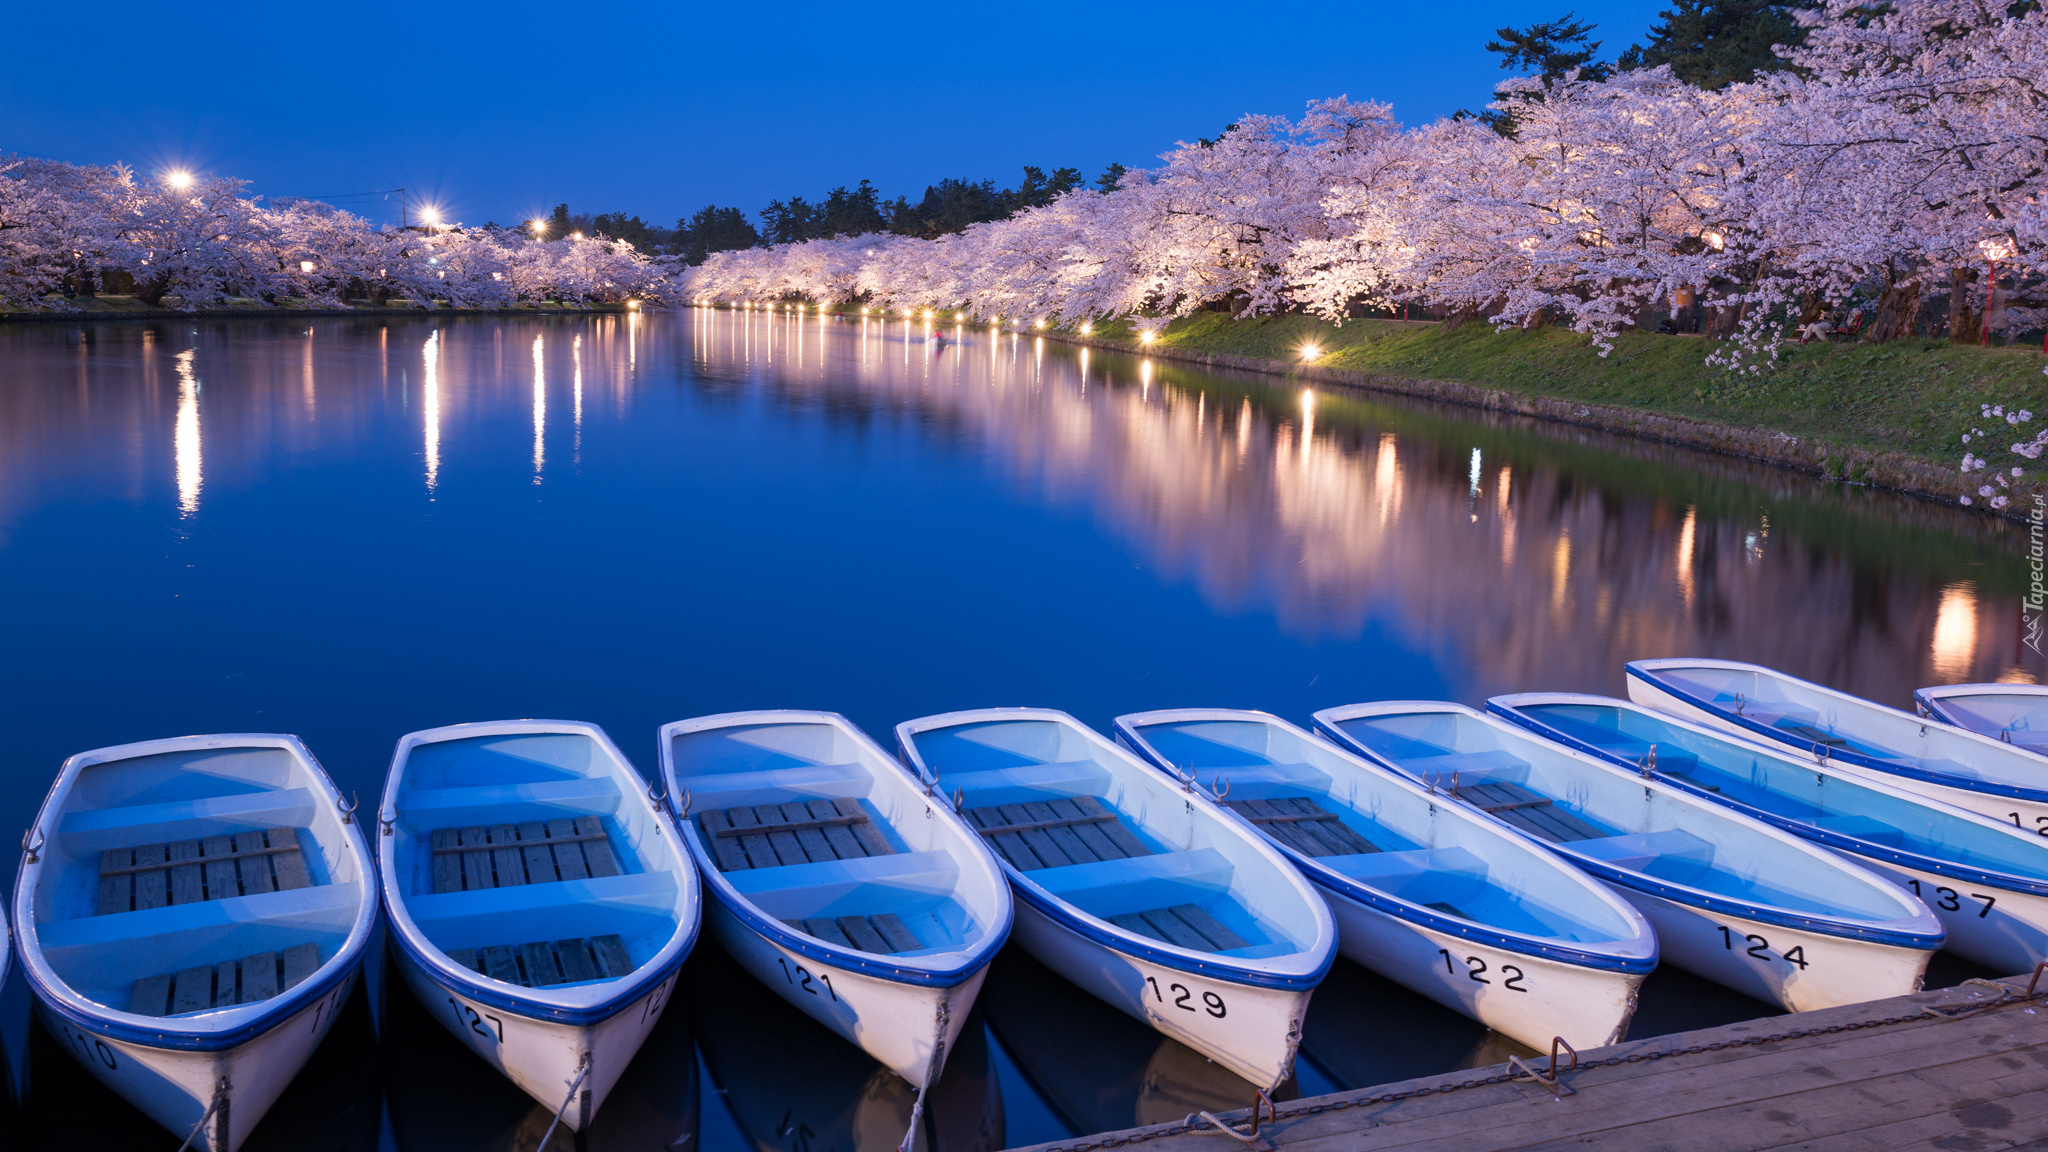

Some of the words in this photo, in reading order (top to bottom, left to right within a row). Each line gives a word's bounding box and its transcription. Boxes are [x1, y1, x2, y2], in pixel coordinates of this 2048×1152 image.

[1908, 879, 1996, 918] 137
[1717, 926, 1809, 971] 124
[778, 957, 837, 1002] 121
[1439, 949, 1527, 993] 122
[1146, 976, 1226, 1019] 129
[448, 997, 504, 1044] 127
[63, 1026, 118, 1070] 110
